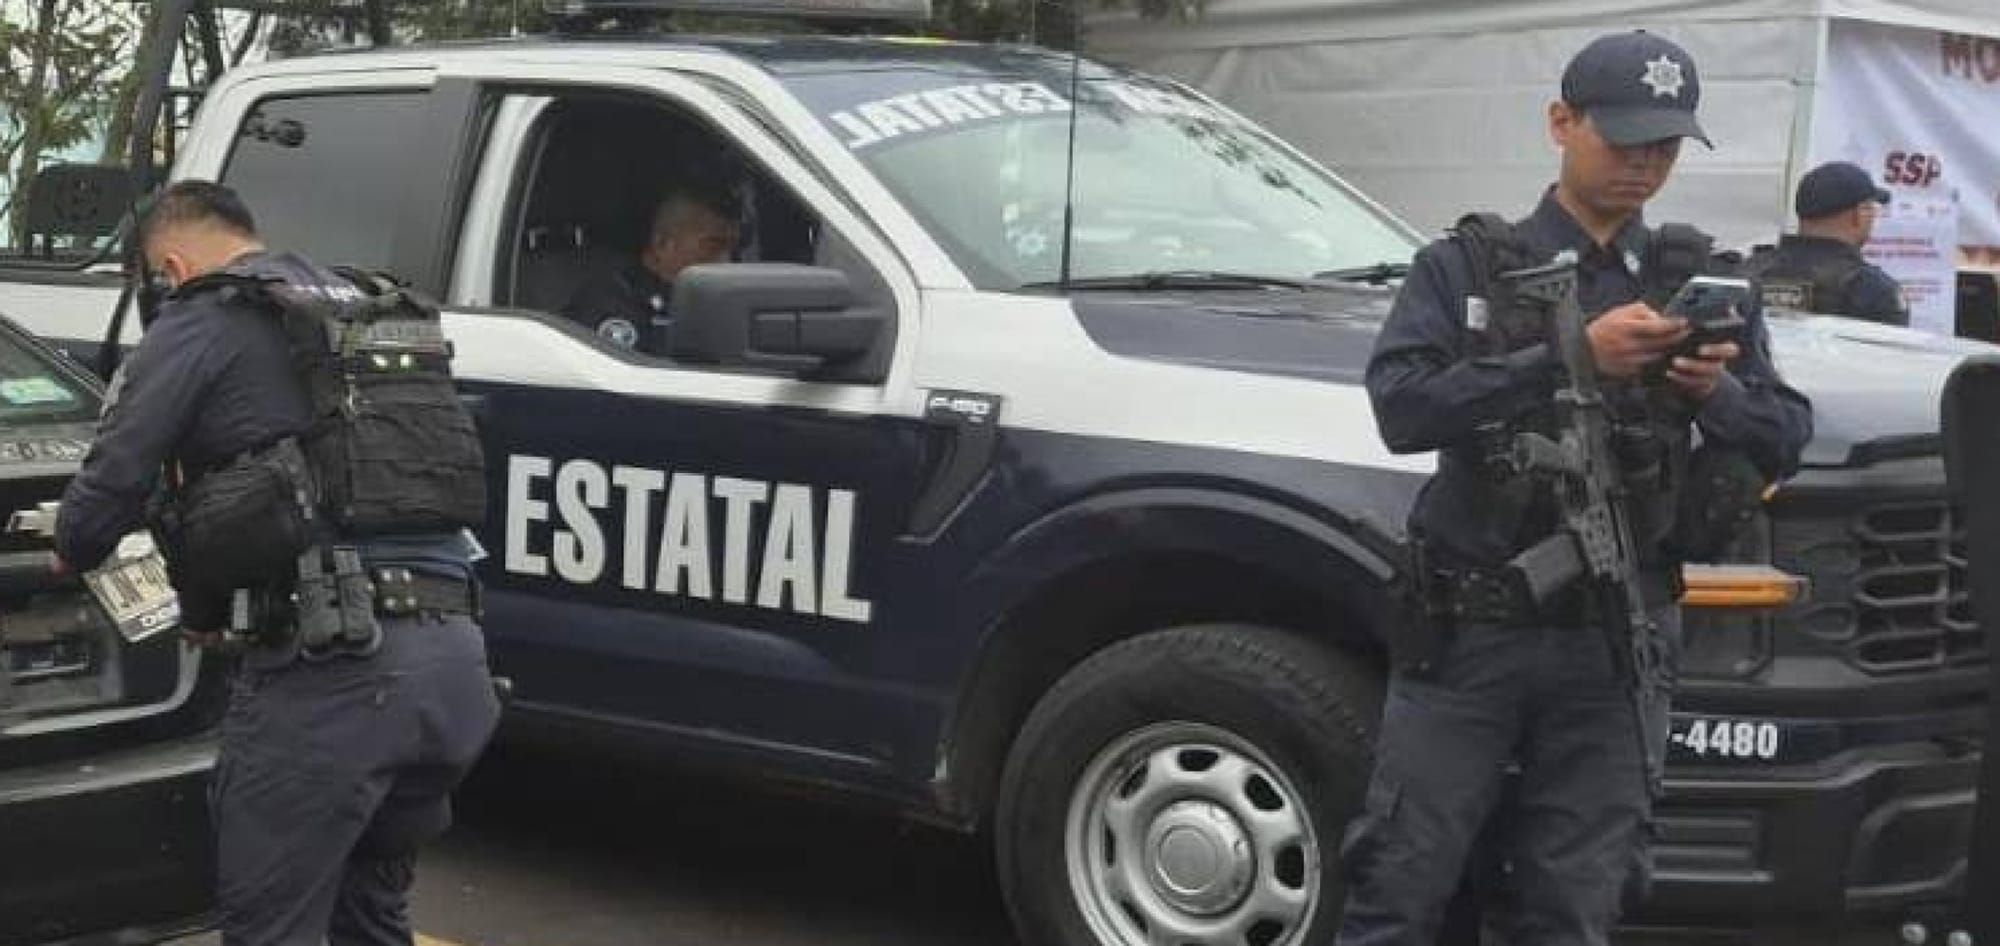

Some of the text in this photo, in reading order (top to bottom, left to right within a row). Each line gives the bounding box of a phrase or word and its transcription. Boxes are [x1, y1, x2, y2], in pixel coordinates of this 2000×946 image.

[1884, 151, 1941, 187] SSP
[505, 453, 871, 622] ESTATAL
[1666, 719, 1778, 759] -4480
